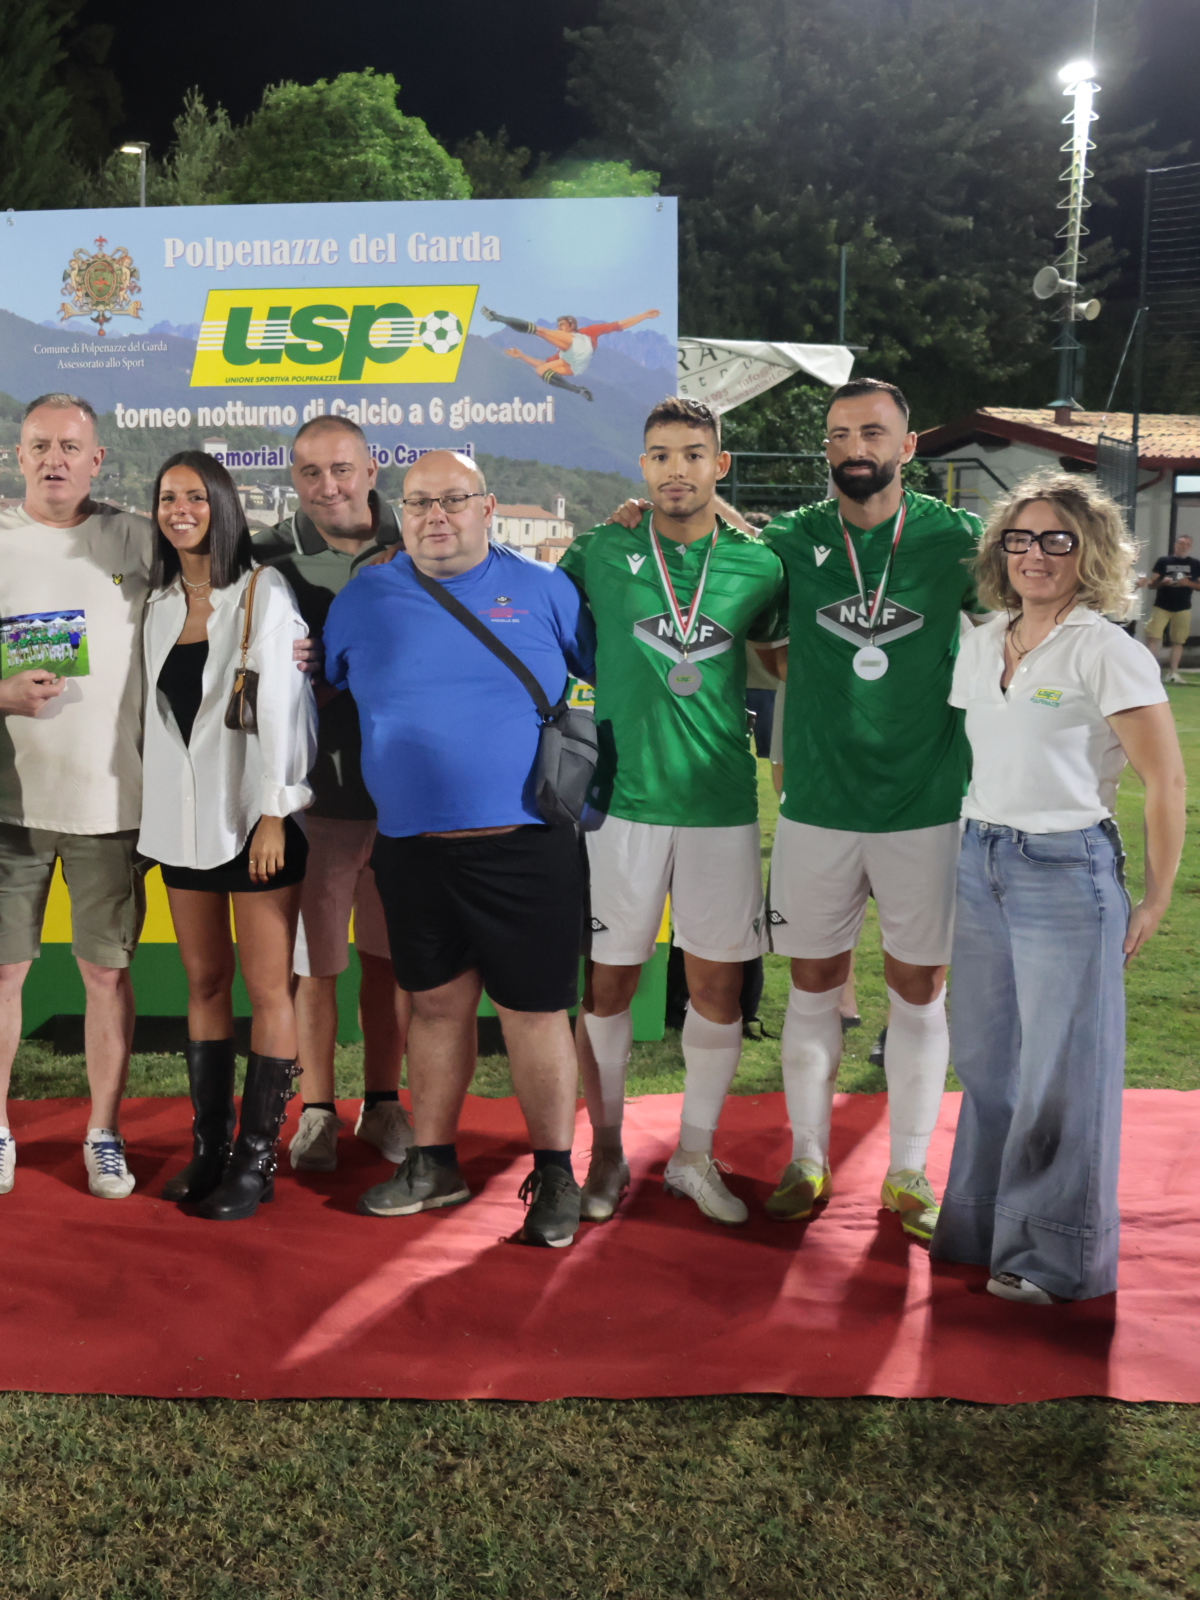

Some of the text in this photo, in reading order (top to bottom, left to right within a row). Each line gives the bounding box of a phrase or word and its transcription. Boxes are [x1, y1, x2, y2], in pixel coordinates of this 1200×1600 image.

[164, 231, 501, 270] Polpenazze del Garda
[33, 341, 168, 356] Comune di Polpenazze del Garda
[221, 302, 415, 381] usp
[57, 358, 145, 370] Assessorato allo Sport
[225, 376, 254, 384] UNIONE
[291, 375, 338, 383] POLPENAZZE
[115, 403, 191, 429] torneo
[197, 401, 298, 427] notturno
[331, 397, 403, 425] Calcio
[408, 403, 424, 425] a
[429, 397, 444, 424] 6
[449, 395, 555, 430] giocatori
[207, 446, 285, 467] emorial
